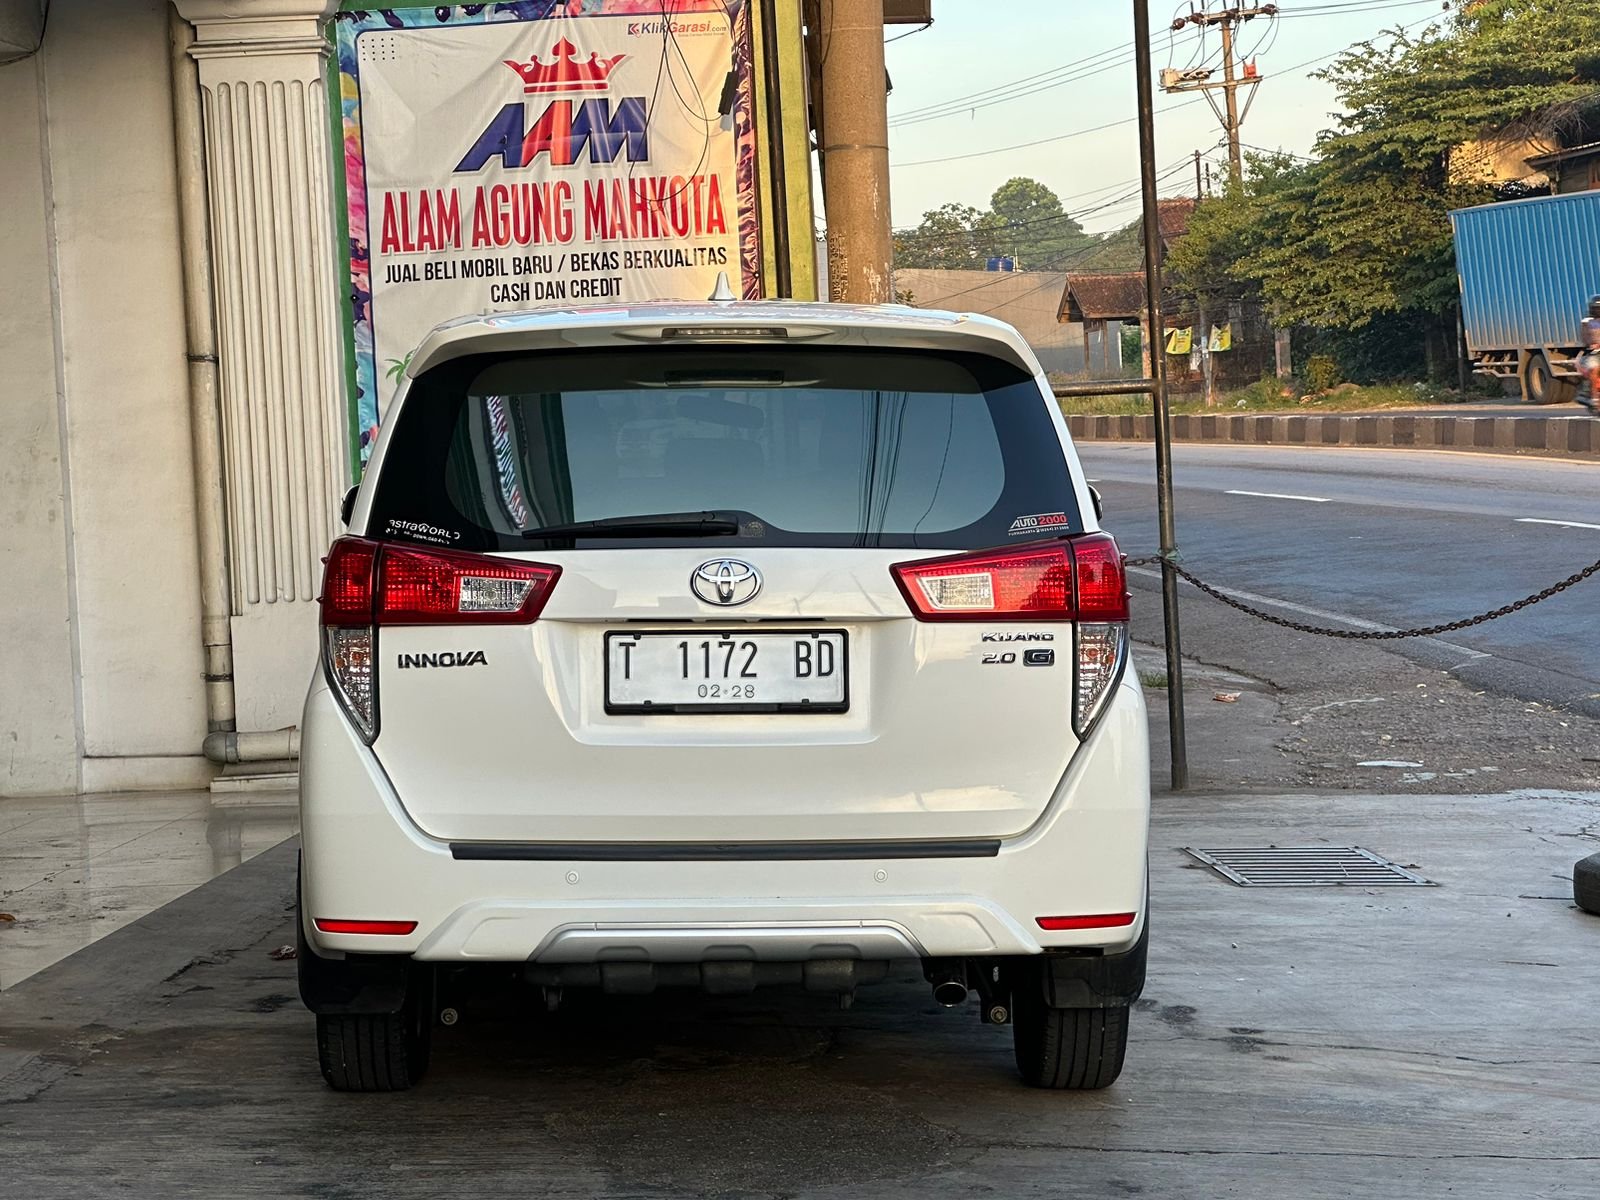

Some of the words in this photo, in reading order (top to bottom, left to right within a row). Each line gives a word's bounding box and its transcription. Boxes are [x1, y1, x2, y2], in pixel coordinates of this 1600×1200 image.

[453, 97, 649, 172] AAM
[381, 188, 461, 254] ALAM
[472, 180, 573, 248] AGUNG
[584, 173, 727, 241] MAHKOTA
[385, 264, 420, 283] JUAL
[424, 261, 457, 281] BELI
[461, 257, 508, 278] MOBIL
[512, 255, 553, 276] BARU
[571, 251, 619, 271] BEKAS
[624, 247, 727, 269] BERKUALITAS
[490, 282, 530, 303] CASH
[534, 280, 566, 300] DAN
[570, 277, 622, 298] CREDIT
[1010, 518, 1037, 529] AUTO
[1038, 515, 1067, 525] 2000
[981, 632, 1054, 642] KIJANG
[398, 650, 488, 669] INNOVA
[619, 642, 636, 679] T
[678, 641, 758, 679] 1172
[795, 640, 834, 678] BD
[982, 652, 1016, 664] 2.0
[1026, 650, 1052, 665] G
